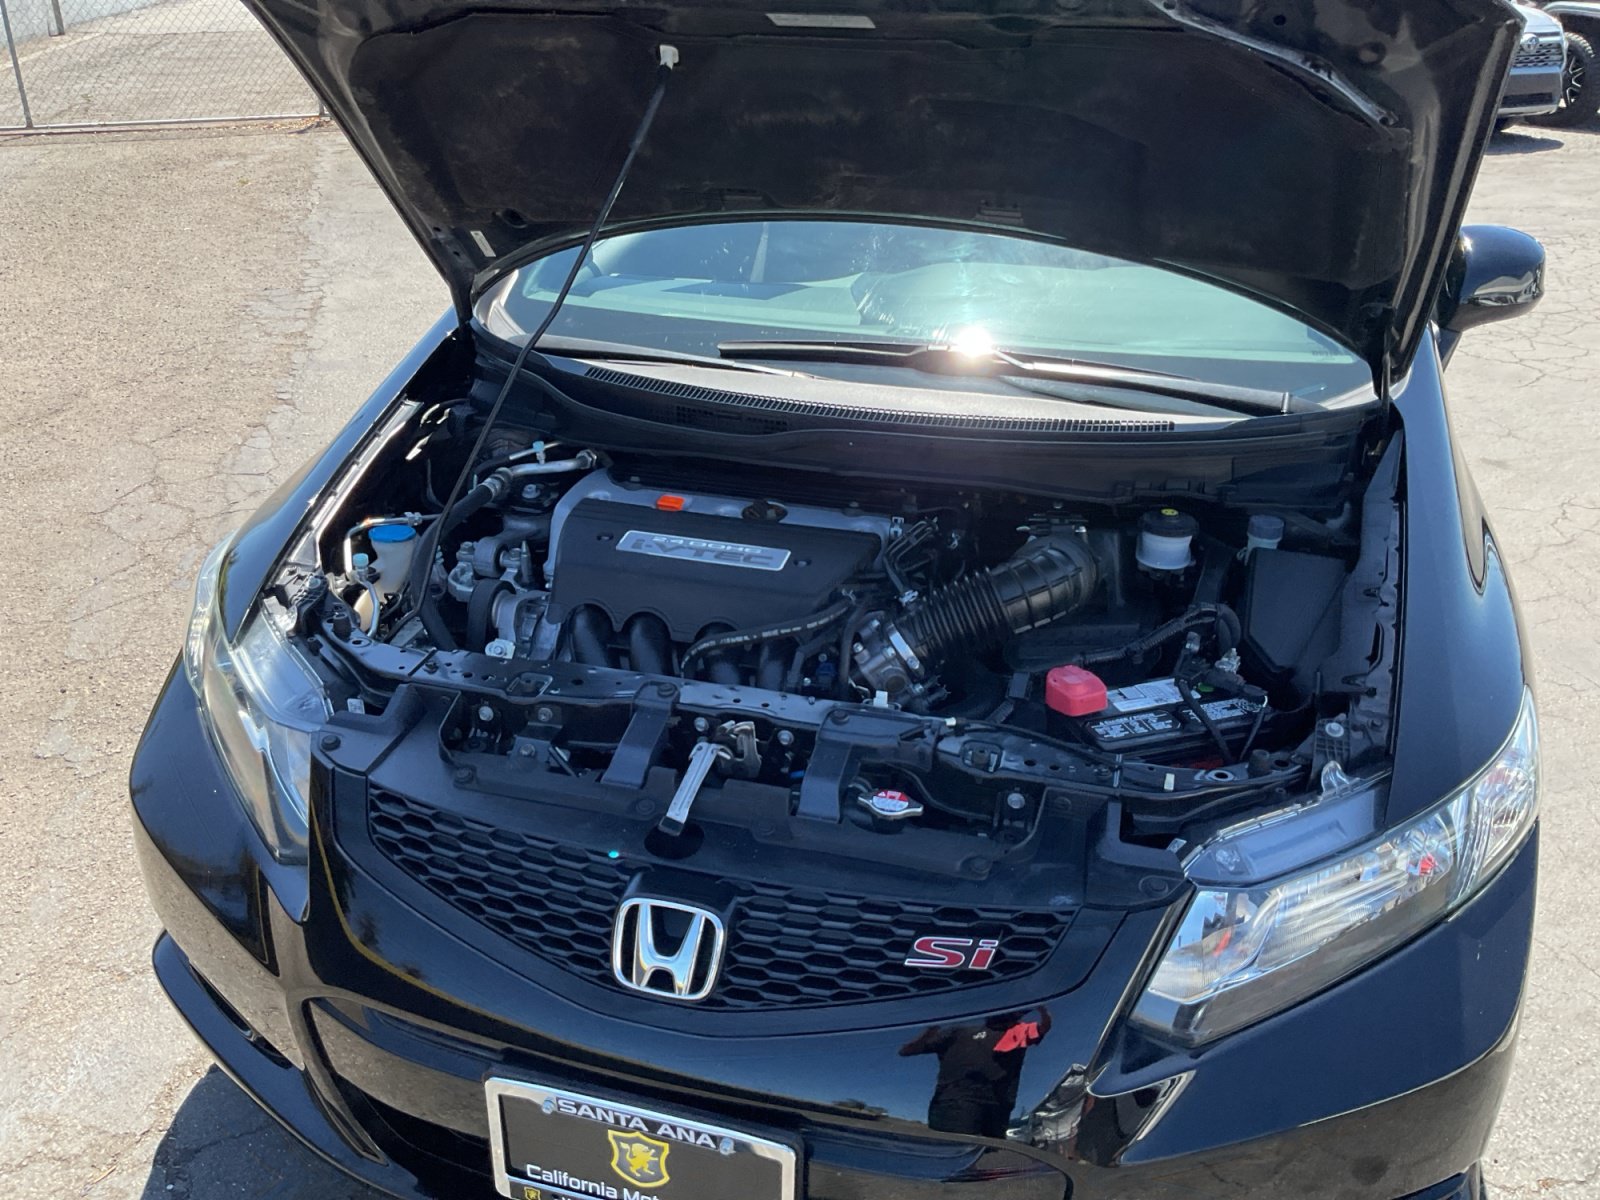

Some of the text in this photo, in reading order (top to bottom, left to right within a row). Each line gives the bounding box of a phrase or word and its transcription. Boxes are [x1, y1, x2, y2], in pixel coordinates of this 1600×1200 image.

[904, 936, 999, 970] Si
[557, 1099, 717, 1149] SANTA ANA
[525, 1163, 619, 1199] California
